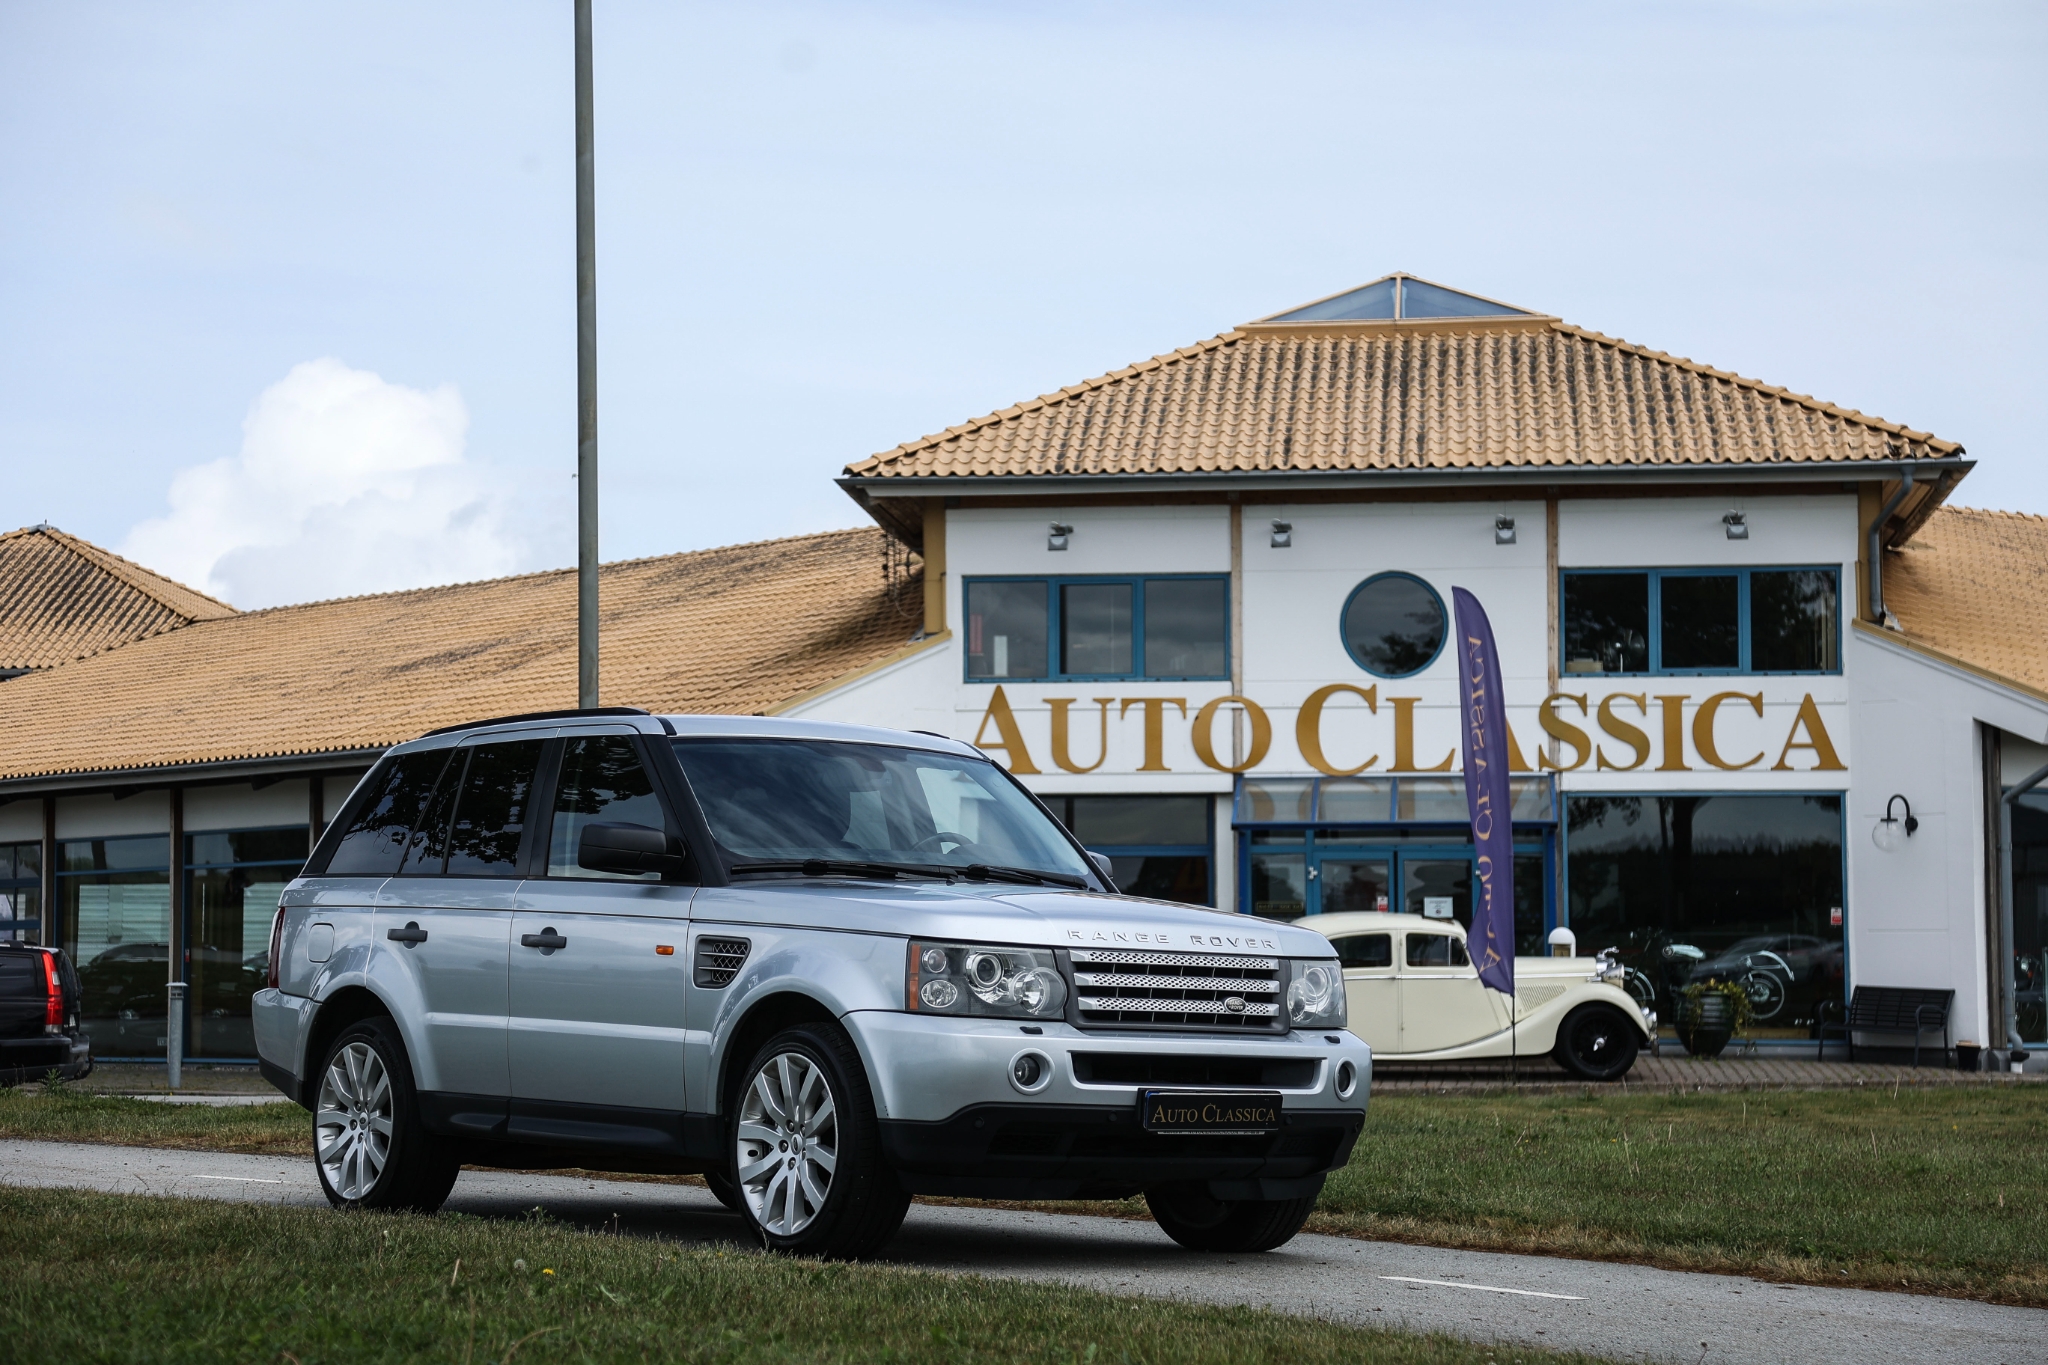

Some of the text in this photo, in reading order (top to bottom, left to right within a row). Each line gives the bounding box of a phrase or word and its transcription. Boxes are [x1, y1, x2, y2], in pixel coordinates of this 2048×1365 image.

[973, 684, 1272, 774] AUTO
[1067, 929, 1276, 949] RANGE ROVER
[1151, 1103, 1276, 1123] AUTO CLASSICA
